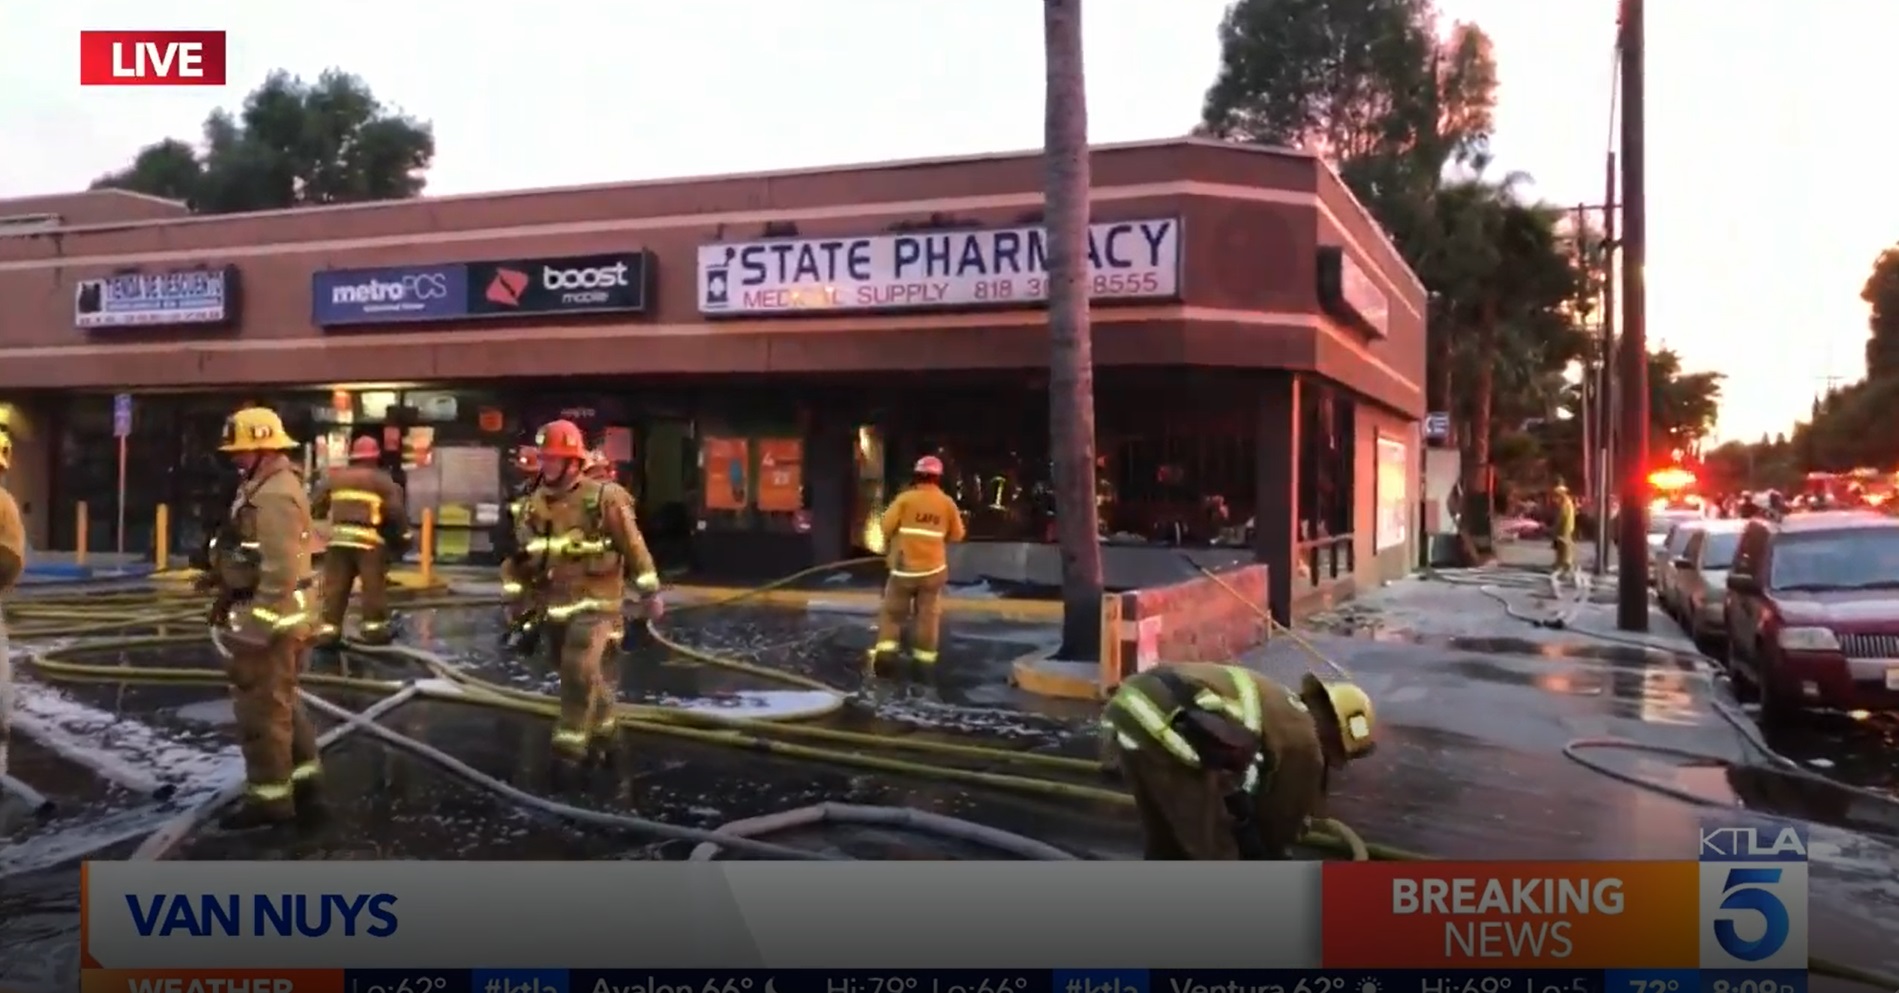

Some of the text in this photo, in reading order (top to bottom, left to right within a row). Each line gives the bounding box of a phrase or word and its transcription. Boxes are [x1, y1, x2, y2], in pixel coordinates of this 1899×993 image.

[543, 261, 629, 290] boost
[741, 240, 871, 286] STATE
[332, 273, 447, 304] metroPCS
[857, 282, 949, 304] SUPPLY
[974, 280, 1012, 300] 818
